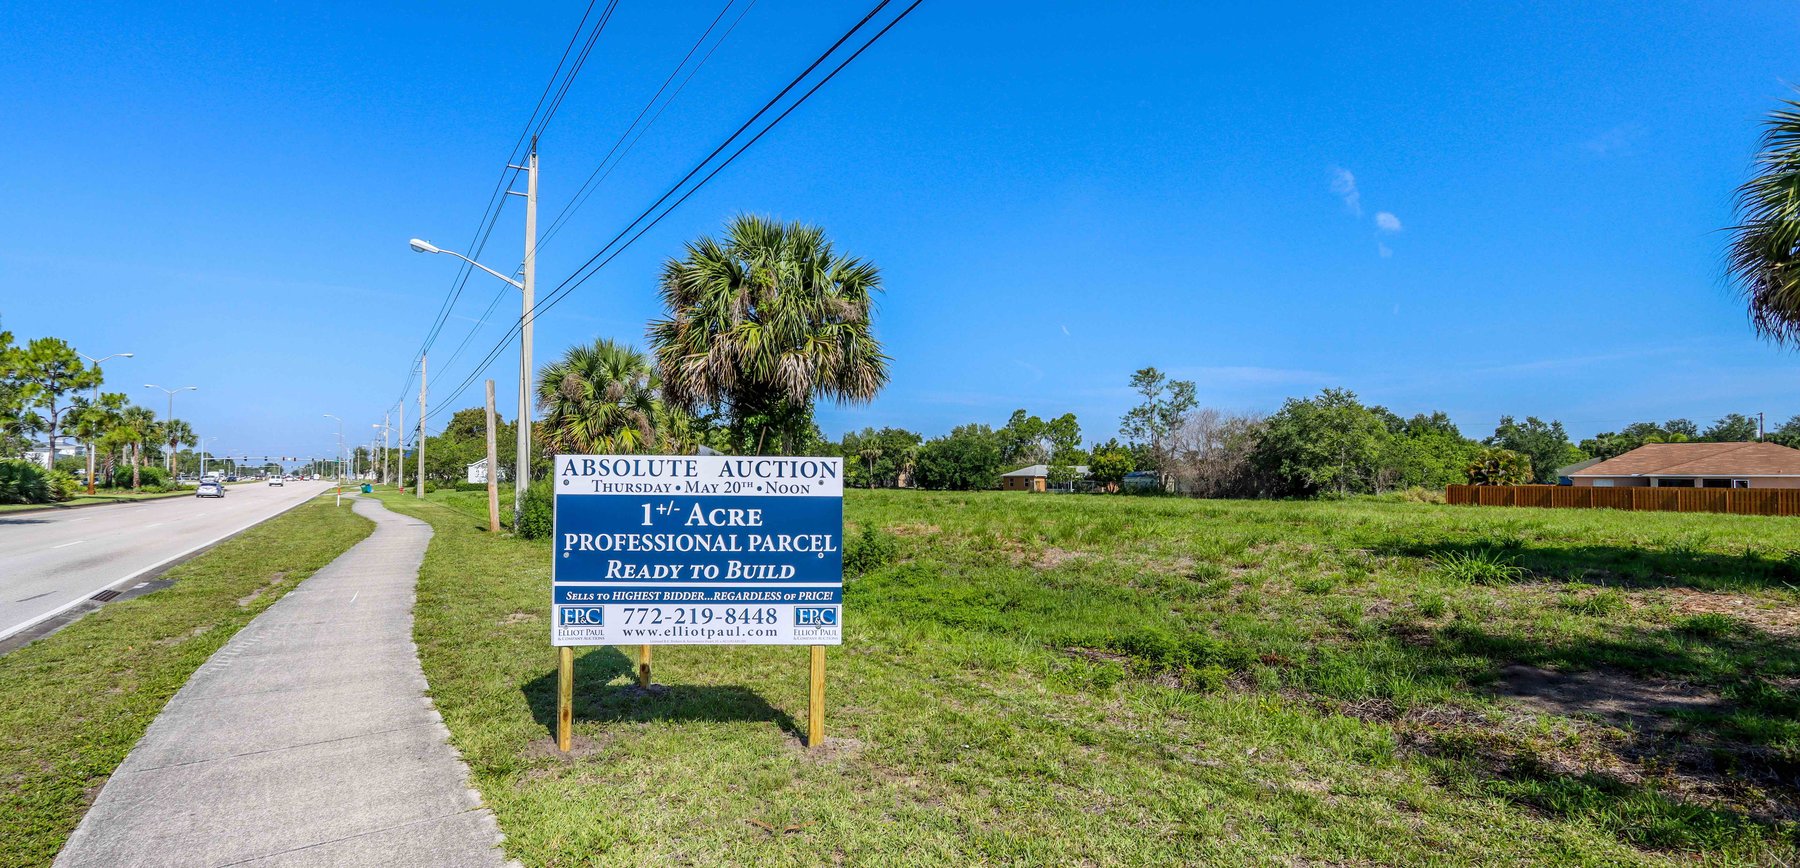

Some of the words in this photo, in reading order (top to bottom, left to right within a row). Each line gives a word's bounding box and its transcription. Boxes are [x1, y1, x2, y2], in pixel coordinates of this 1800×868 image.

[562, 459, 698, 477] ABSOLUTE
[718, 460, 837, 478] AUCTION
[724, 481, 753, 493] 20TH
[563, 533, 743, 552] PROFESSIONAL
[747, 534, 837, 552] PARCEL
[611, 591, 661, 601] HIGHEST
[797, 591, 834, 601] PRICE!
[623, 607, 778, 625] 772-219-8448
[622, 626, 778, 639] www.elliotpaul.com
